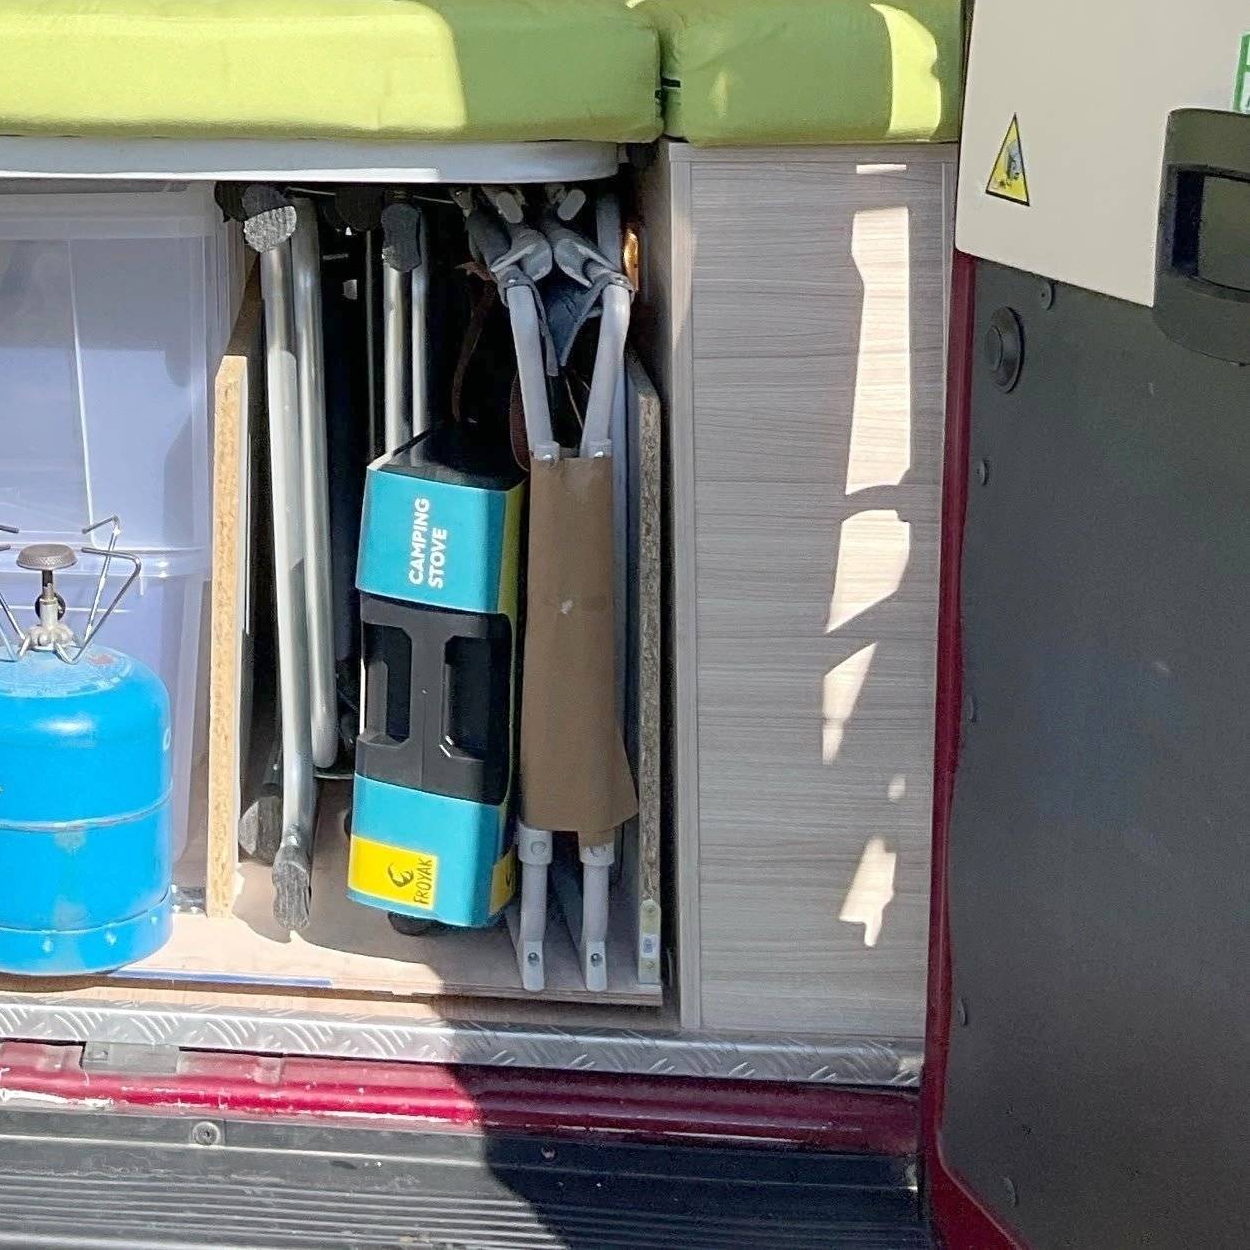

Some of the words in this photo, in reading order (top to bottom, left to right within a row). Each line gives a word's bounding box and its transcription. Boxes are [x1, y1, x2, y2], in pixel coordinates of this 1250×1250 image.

[408, 497, 430, 585] CAMPING
[428, 527, 447, 590] STOVE
[413, 857, 433, 905] FROYAK
